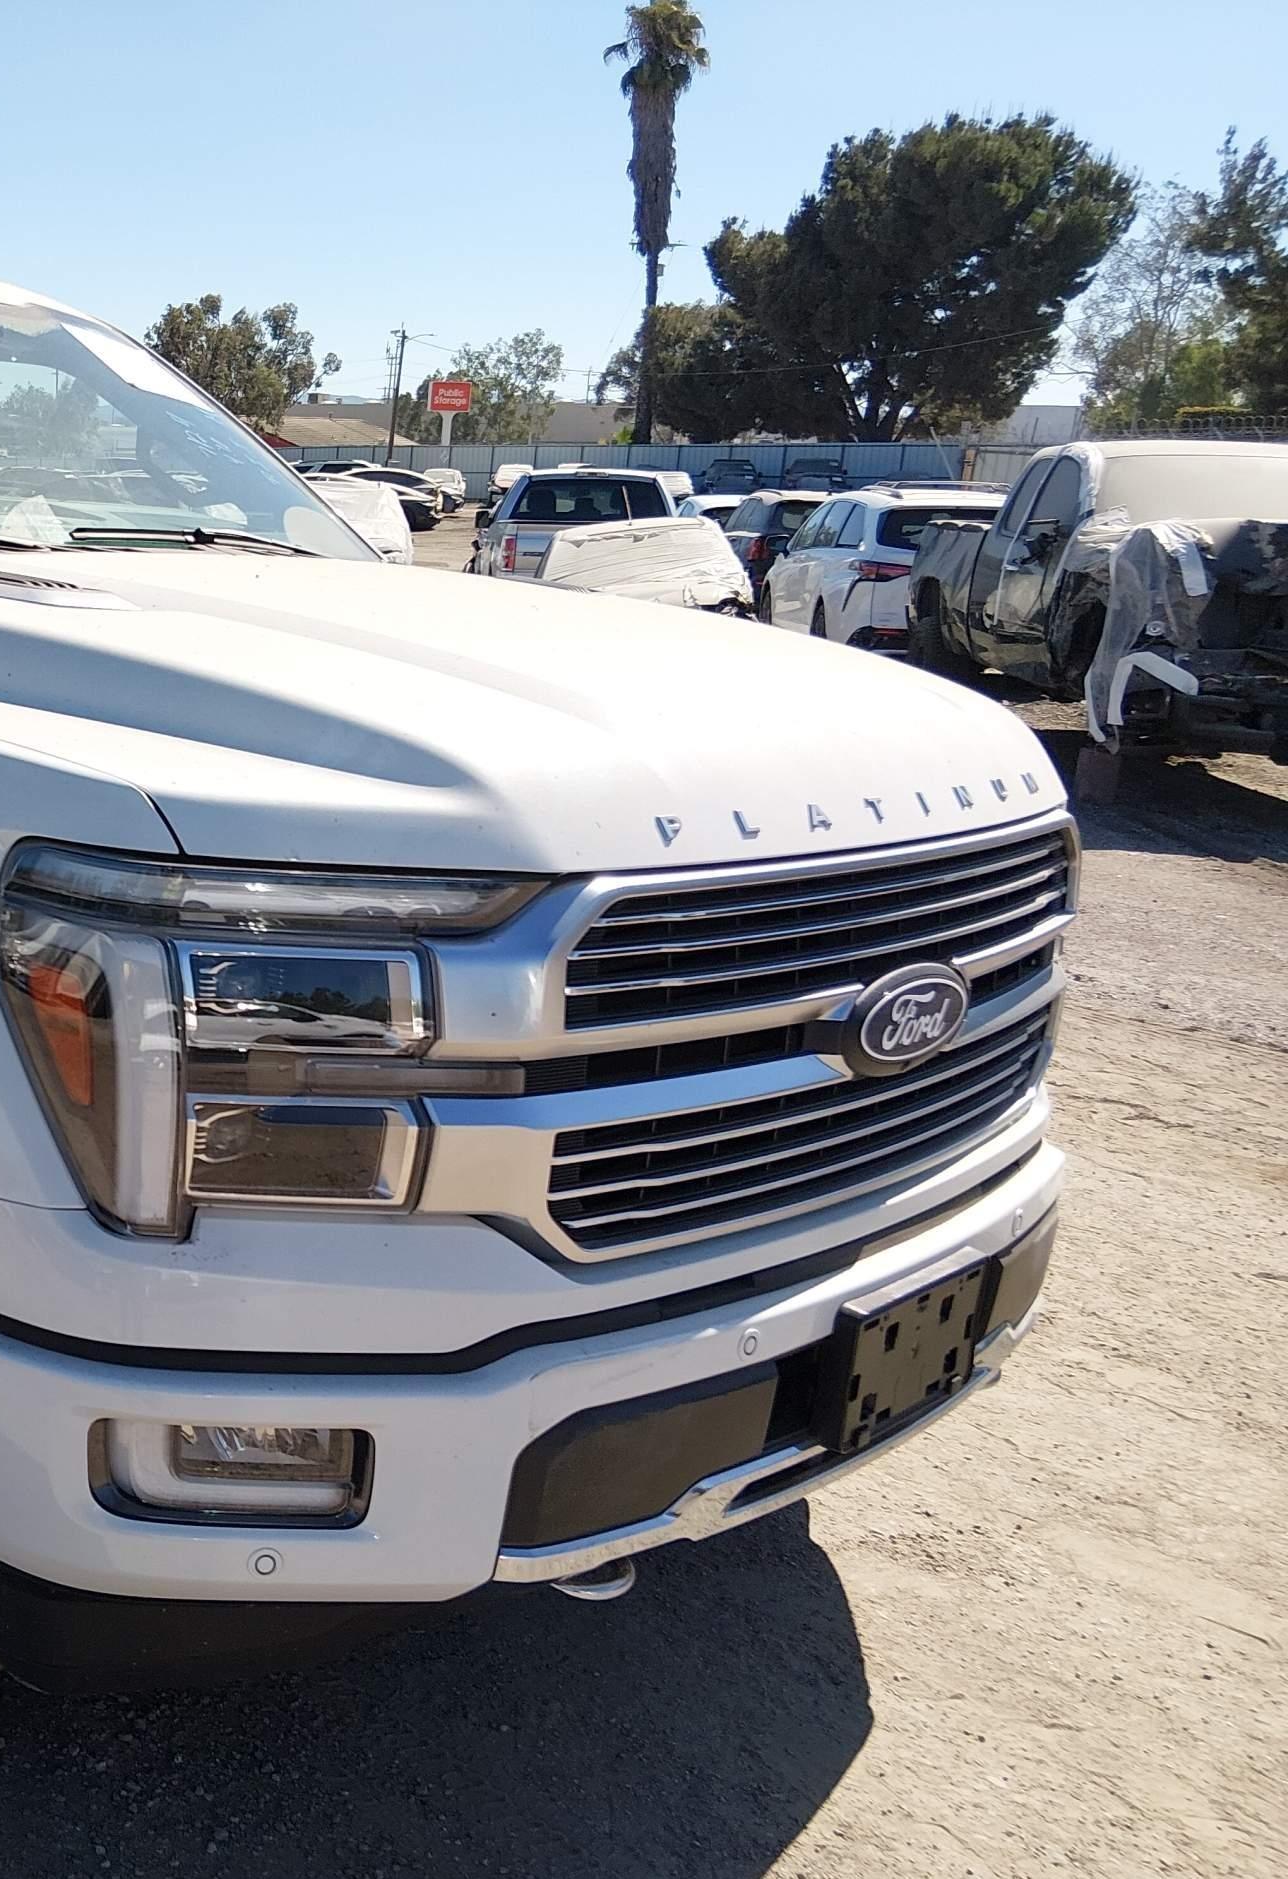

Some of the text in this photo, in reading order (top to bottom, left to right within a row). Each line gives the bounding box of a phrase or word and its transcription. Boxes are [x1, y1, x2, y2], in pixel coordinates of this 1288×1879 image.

[433, 395, 467, 407] Storage
[438, 388, 465, 397] Public
[654, 772, 1040, 848] PLATINUM
[881, 990, 951, 1051] Ford
